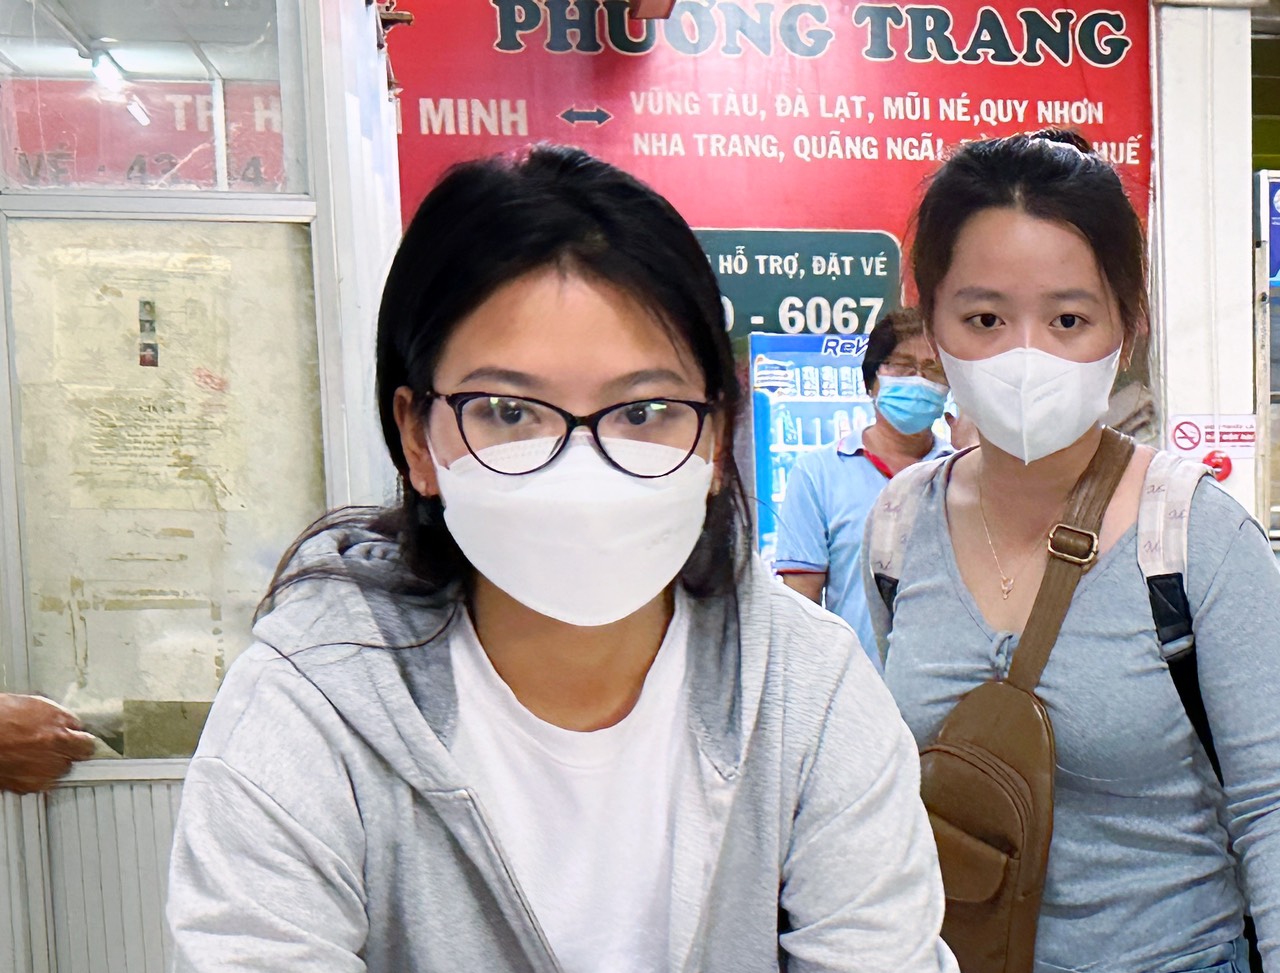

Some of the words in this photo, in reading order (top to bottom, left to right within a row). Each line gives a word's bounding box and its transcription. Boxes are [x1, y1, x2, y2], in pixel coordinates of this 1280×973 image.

[854, 2, 1132, 67] TRANG
[419, 98, 528, 136] MINH
[630, 87, 700, 116] VŨNG
[707, 87, 767, 122] TÀU,
[775, 88, 810, 118] ĐÀ
[819, 95, 875, 124] LẠT,
[883, 91, 931, 121] MŨI
[1037, 98, 1104, 124] NHƠN
[632, 132, 685, 156] NHA
[693, 133, 785, 163] TRANG,
[719, 245, 748, 275] HỖ
[755, 252, 805, 279] TRỢ,
[812, 252, 854, 280] ĐẶT
[860, 251, 887, 276] VÉ
[779, 296, 884, 334] 6067
